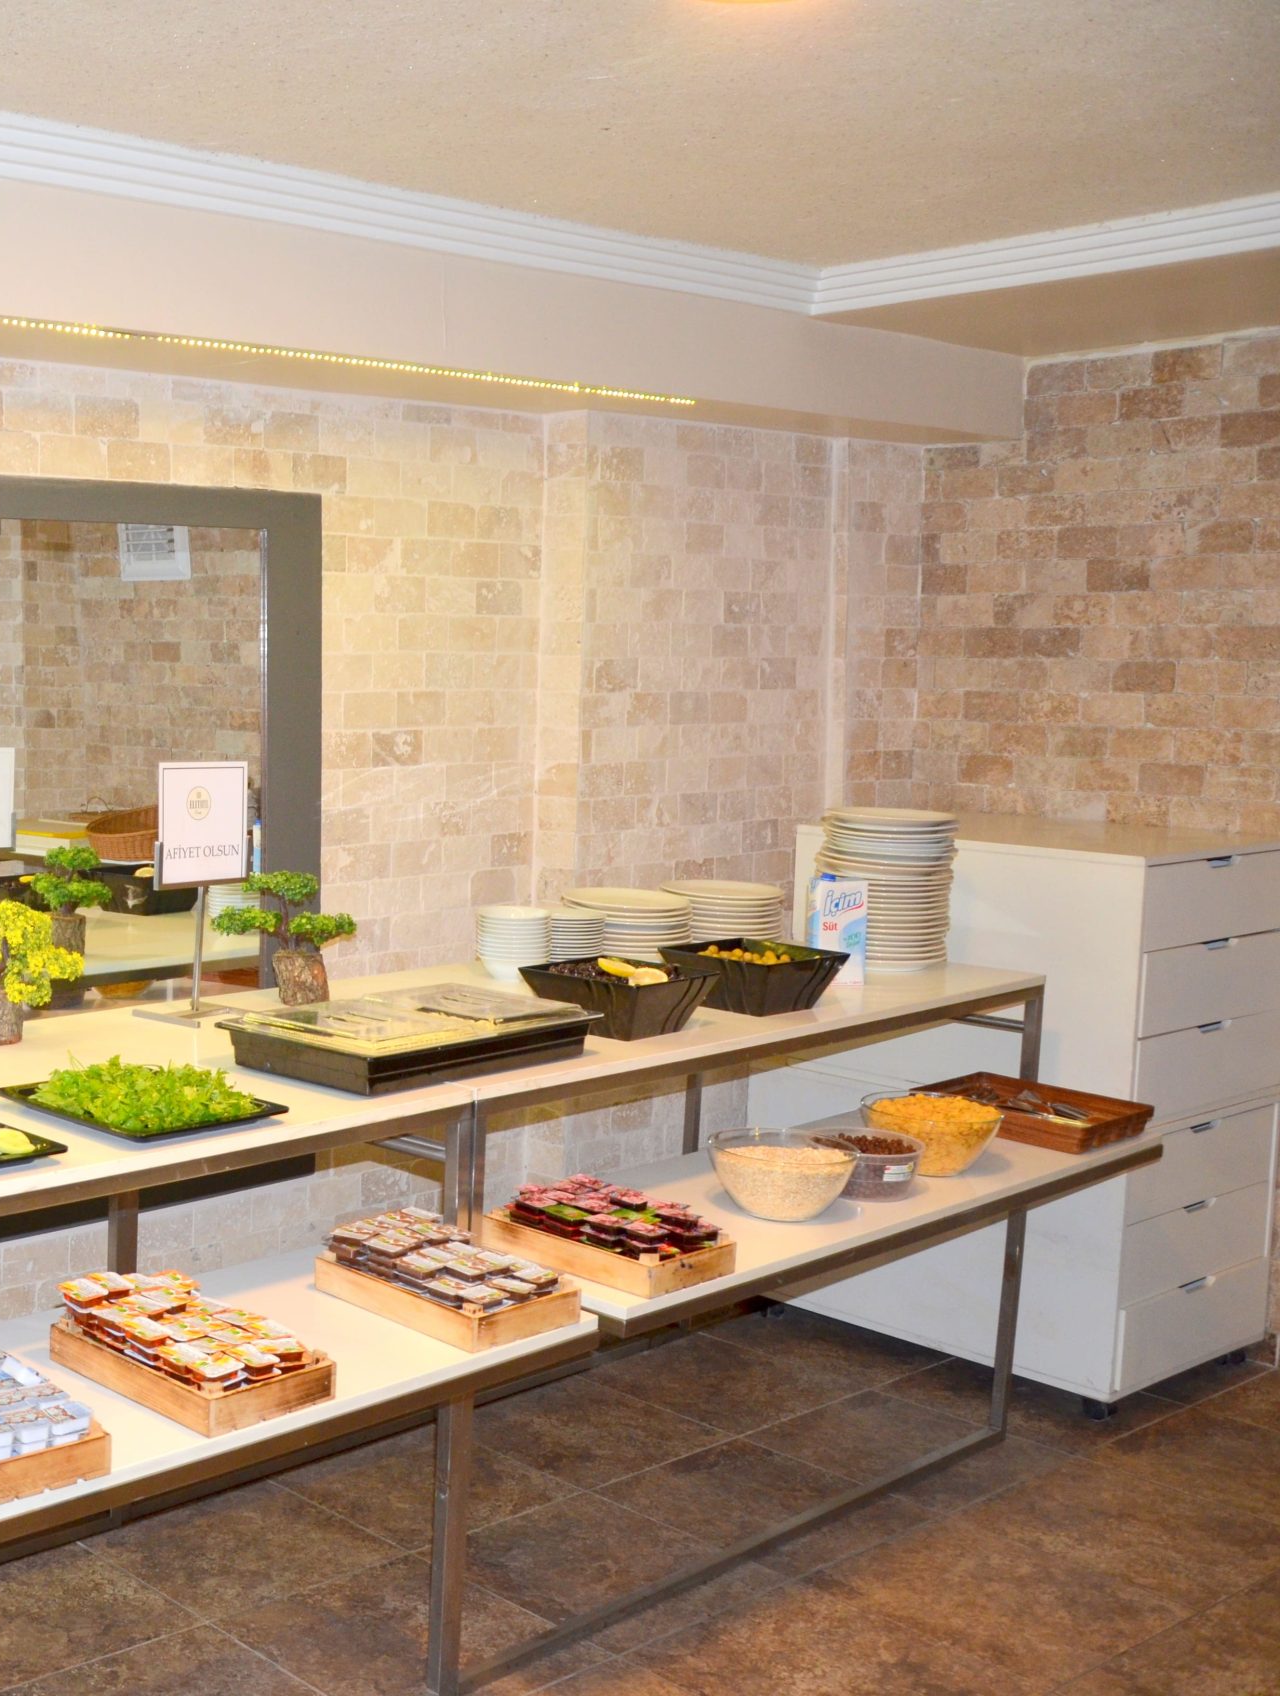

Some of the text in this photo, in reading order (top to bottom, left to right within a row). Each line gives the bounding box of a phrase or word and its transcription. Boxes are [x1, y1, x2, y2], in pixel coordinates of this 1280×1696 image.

[165, 844, 240, 861] AFİYET OLSUN
[822, 921, 838, 931] Süt
